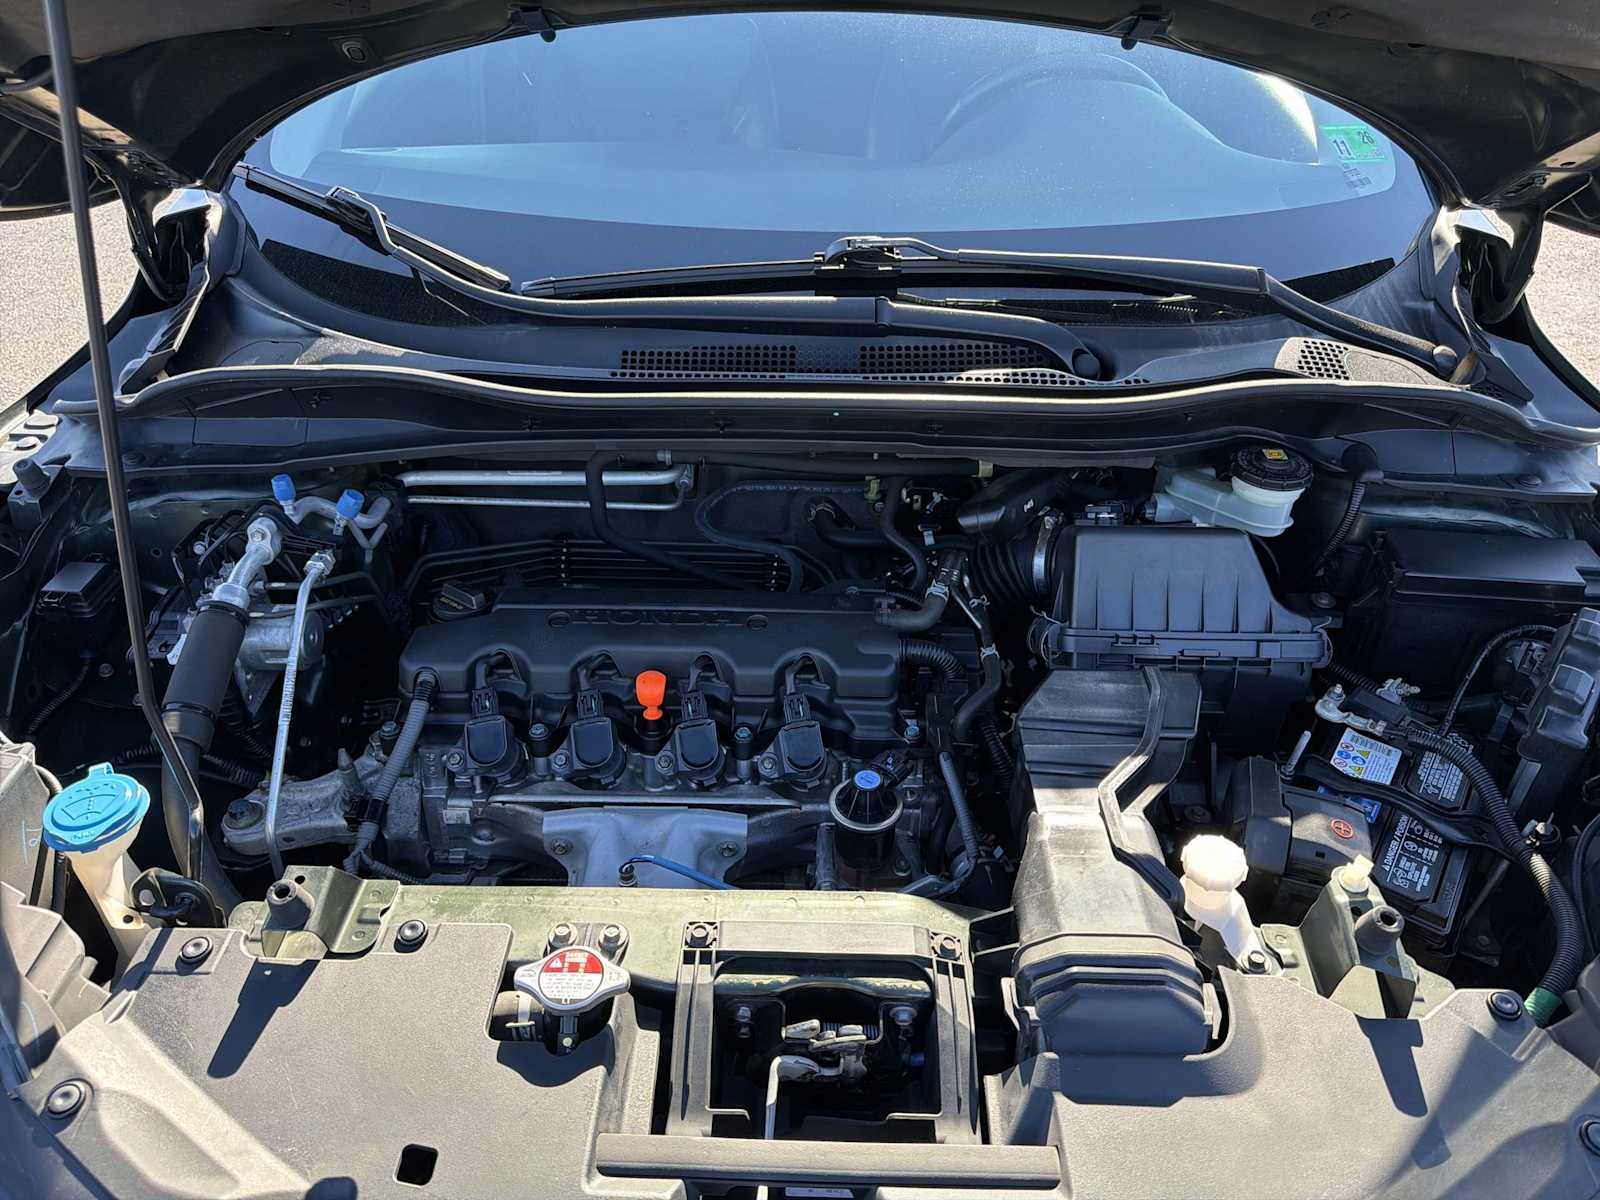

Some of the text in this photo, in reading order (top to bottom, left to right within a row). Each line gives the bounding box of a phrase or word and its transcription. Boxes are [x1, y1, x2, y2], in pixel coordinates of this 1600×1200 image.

[1357, 130, 1375, 145] 26
[1332, 139, 1351, 156] 11
[572, 609, 744, 626] HONDA
